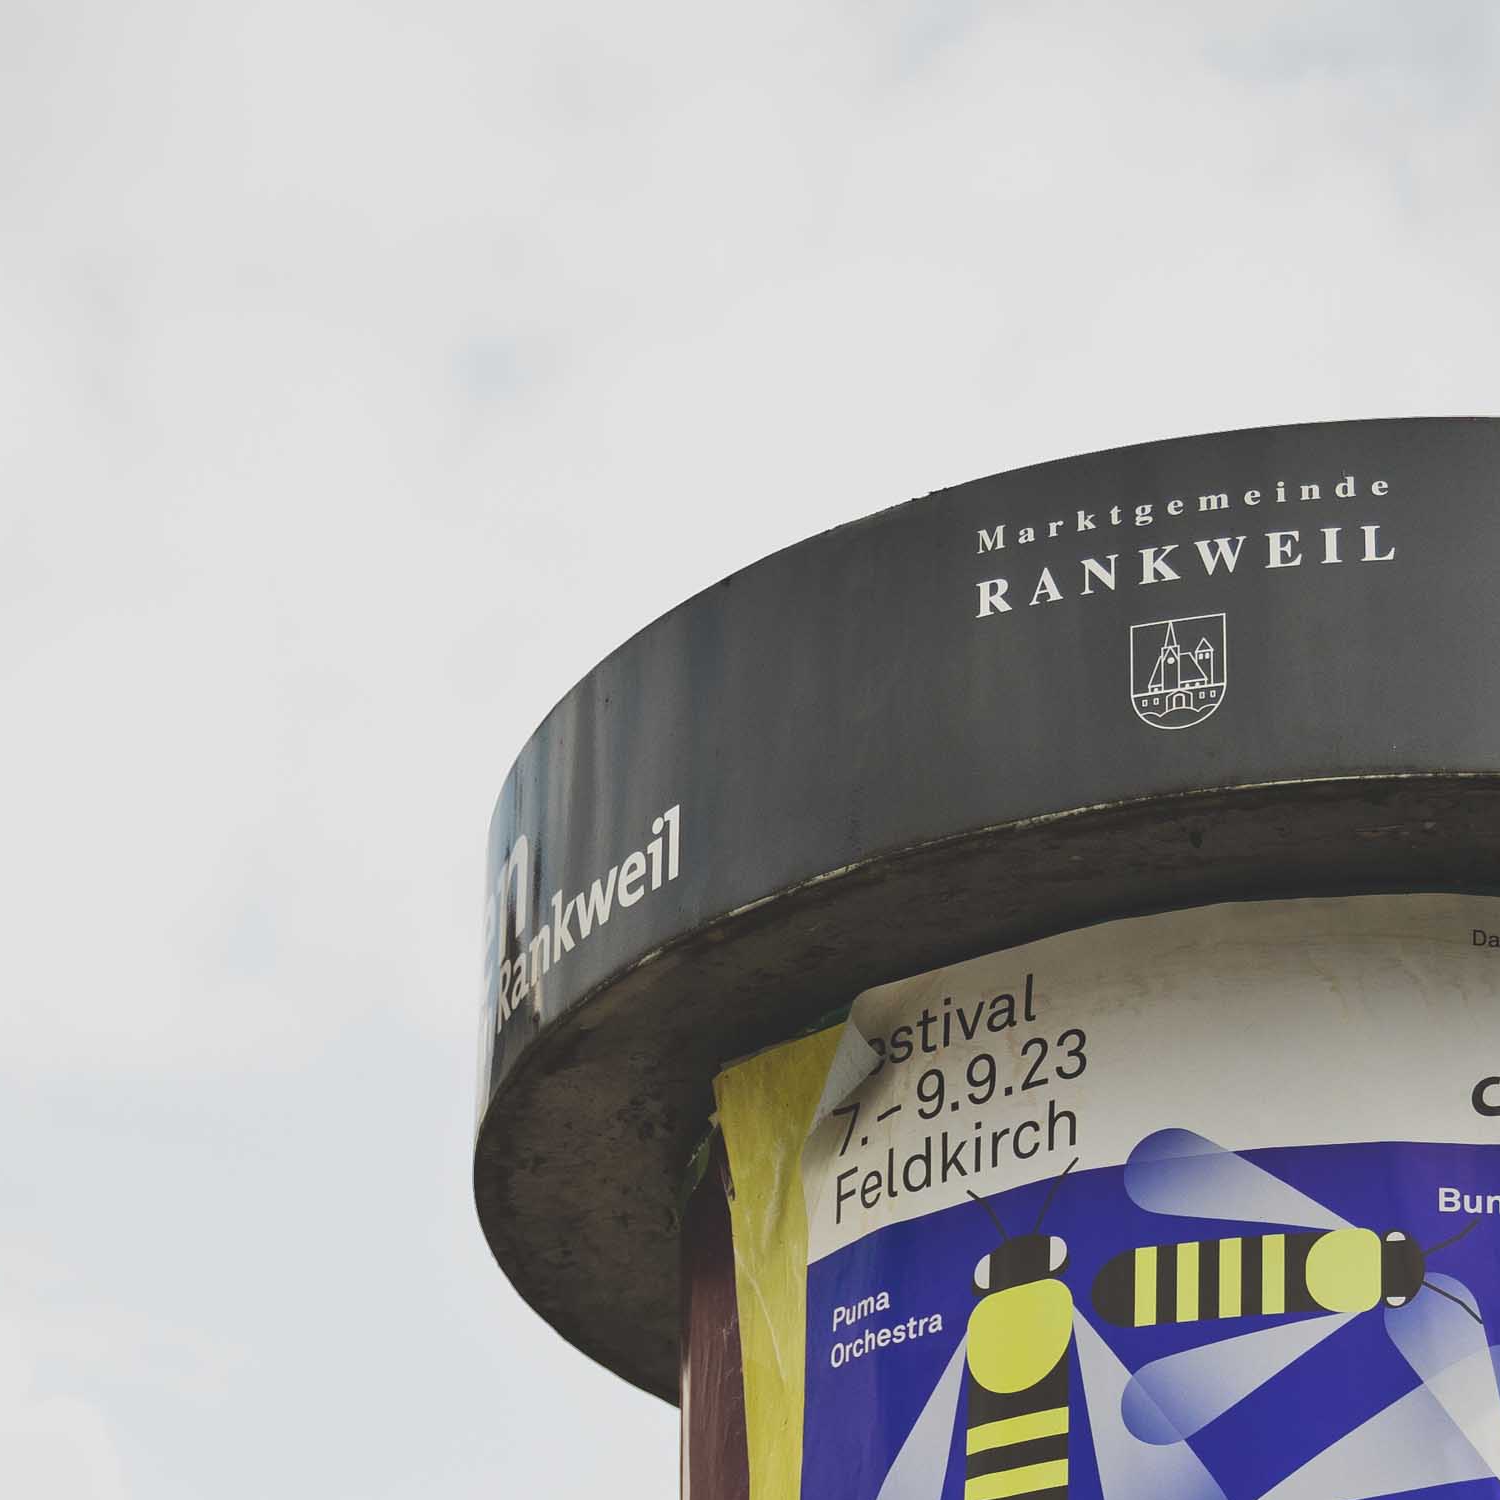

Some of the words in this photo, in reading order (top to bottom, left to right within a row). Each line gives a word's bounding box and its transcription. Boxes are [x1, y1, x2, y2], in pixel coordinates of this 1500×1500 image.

[976, 475, 1390, 554] Marktgemeinde
[975, 525, 1396, 618] RANKWEIL
[496, 804, 681, 1035] Rankweil
[916, 1028, 1088, 1119] 9.9.23
[835, 1099, 1078, 1225] Feldkirch
[830, 1313, 944, 1369] Orchestra
[832, 1291, 891, 1333] Puma
